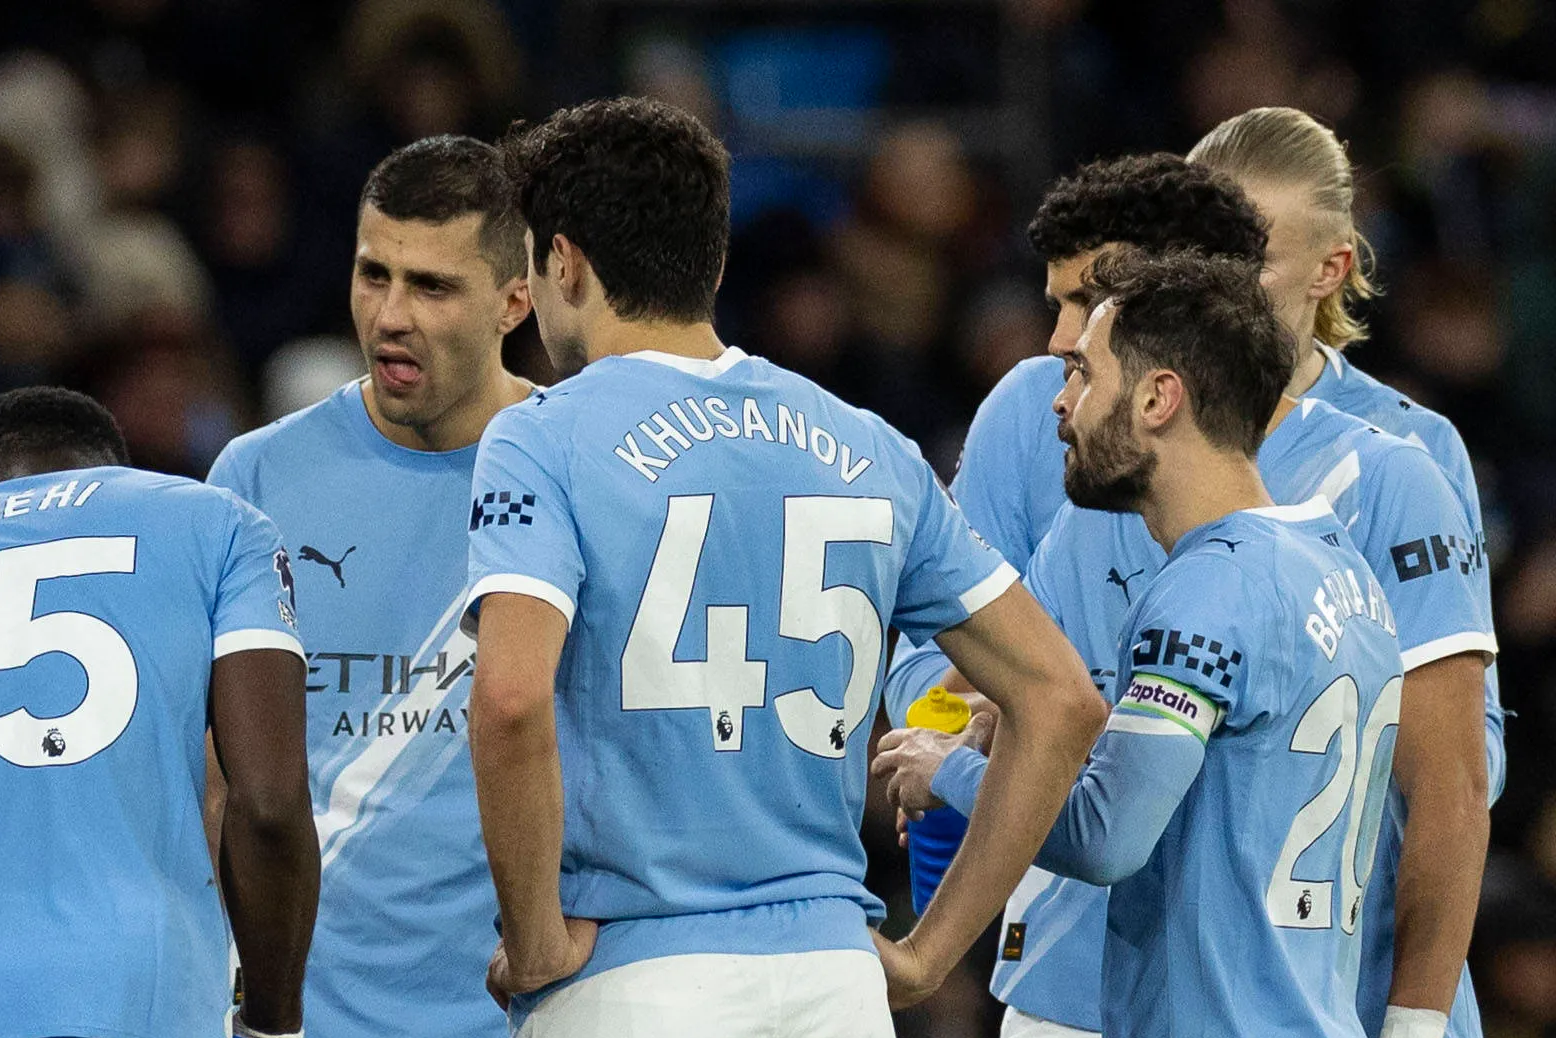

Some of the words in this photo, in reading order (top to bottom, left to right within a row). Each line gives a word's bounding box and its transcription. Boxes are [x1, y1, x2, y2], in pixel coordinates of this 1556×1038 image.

[613, 396, 874, 485] KHUSANOV
[619, 493, 895, 760] 45
[1266, 674, 1404, 936] 20
